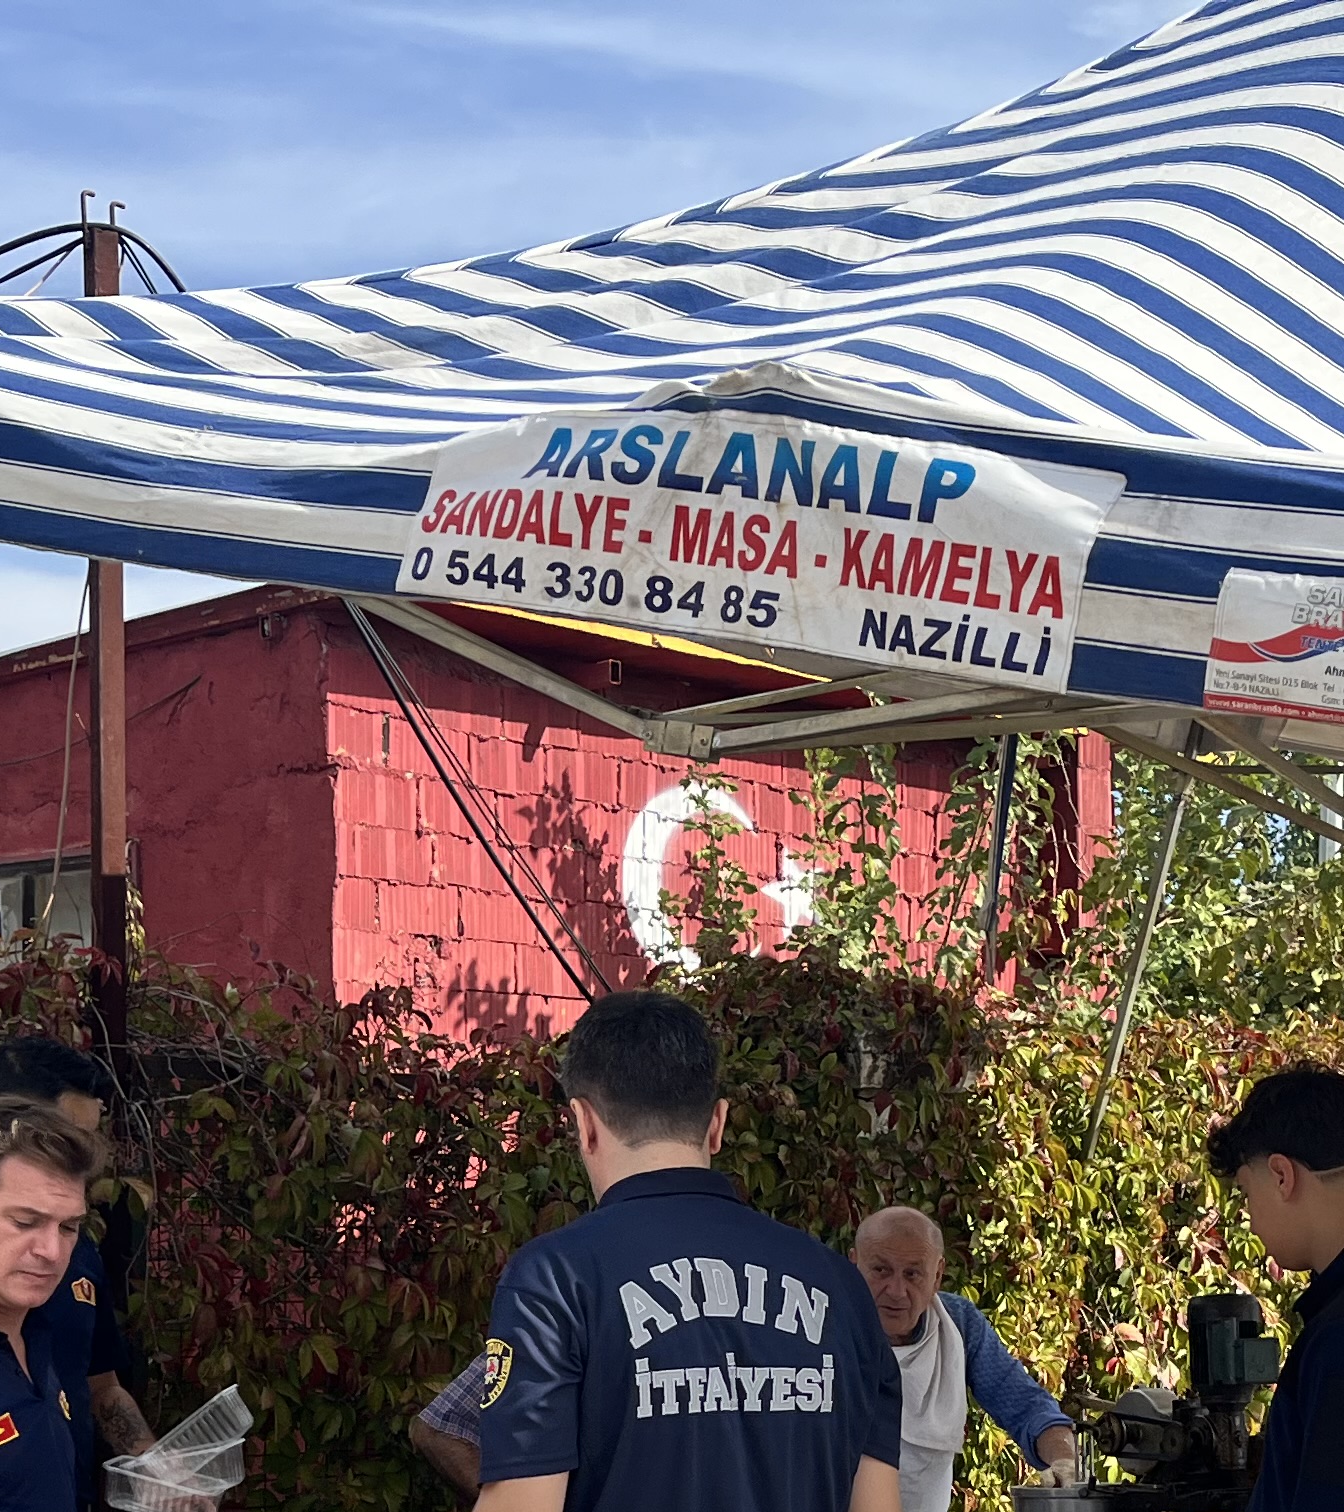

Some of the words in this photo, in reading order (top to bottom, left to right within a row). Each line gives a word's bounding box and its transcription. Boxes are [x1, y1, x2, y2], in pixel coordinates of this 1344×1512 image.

[523, 424, 977, 525] ARSLANALP
[411, 547, 434, 581] 0
[445, 550, 527, 593] 544
[545, 561, 624, 606] 330
[645, 575, 705, 619] 84
[720, 583, 781, 628] 85
[421, 487, 631, 554] SANDALYE
[670, 504, 798, 578] MASA
[840, 528, 1064, 619] KAMELYA
[859, 608, 1052, 676] NAZİLLİ
[619, 1257, 829, 1349] AYDIN
[635, 1352, 834, 1419] İTFAİYESİ
